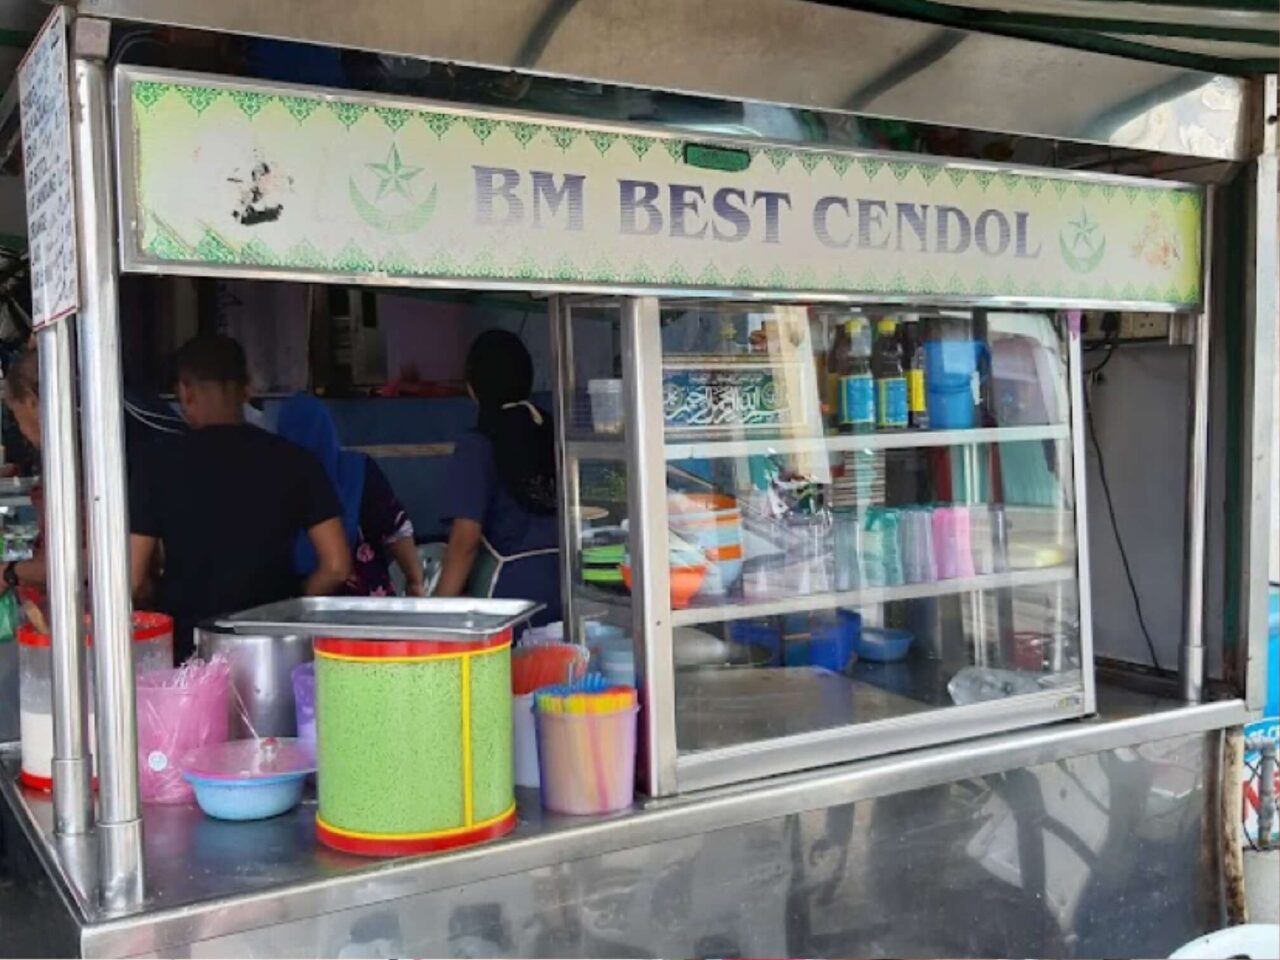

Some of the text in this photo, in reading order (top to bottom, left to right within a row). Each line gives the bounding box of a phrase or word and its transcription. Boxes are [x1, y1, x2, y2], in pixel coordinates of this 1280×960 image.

[471, 165, 1042, 259] BM BEST CENDOL
